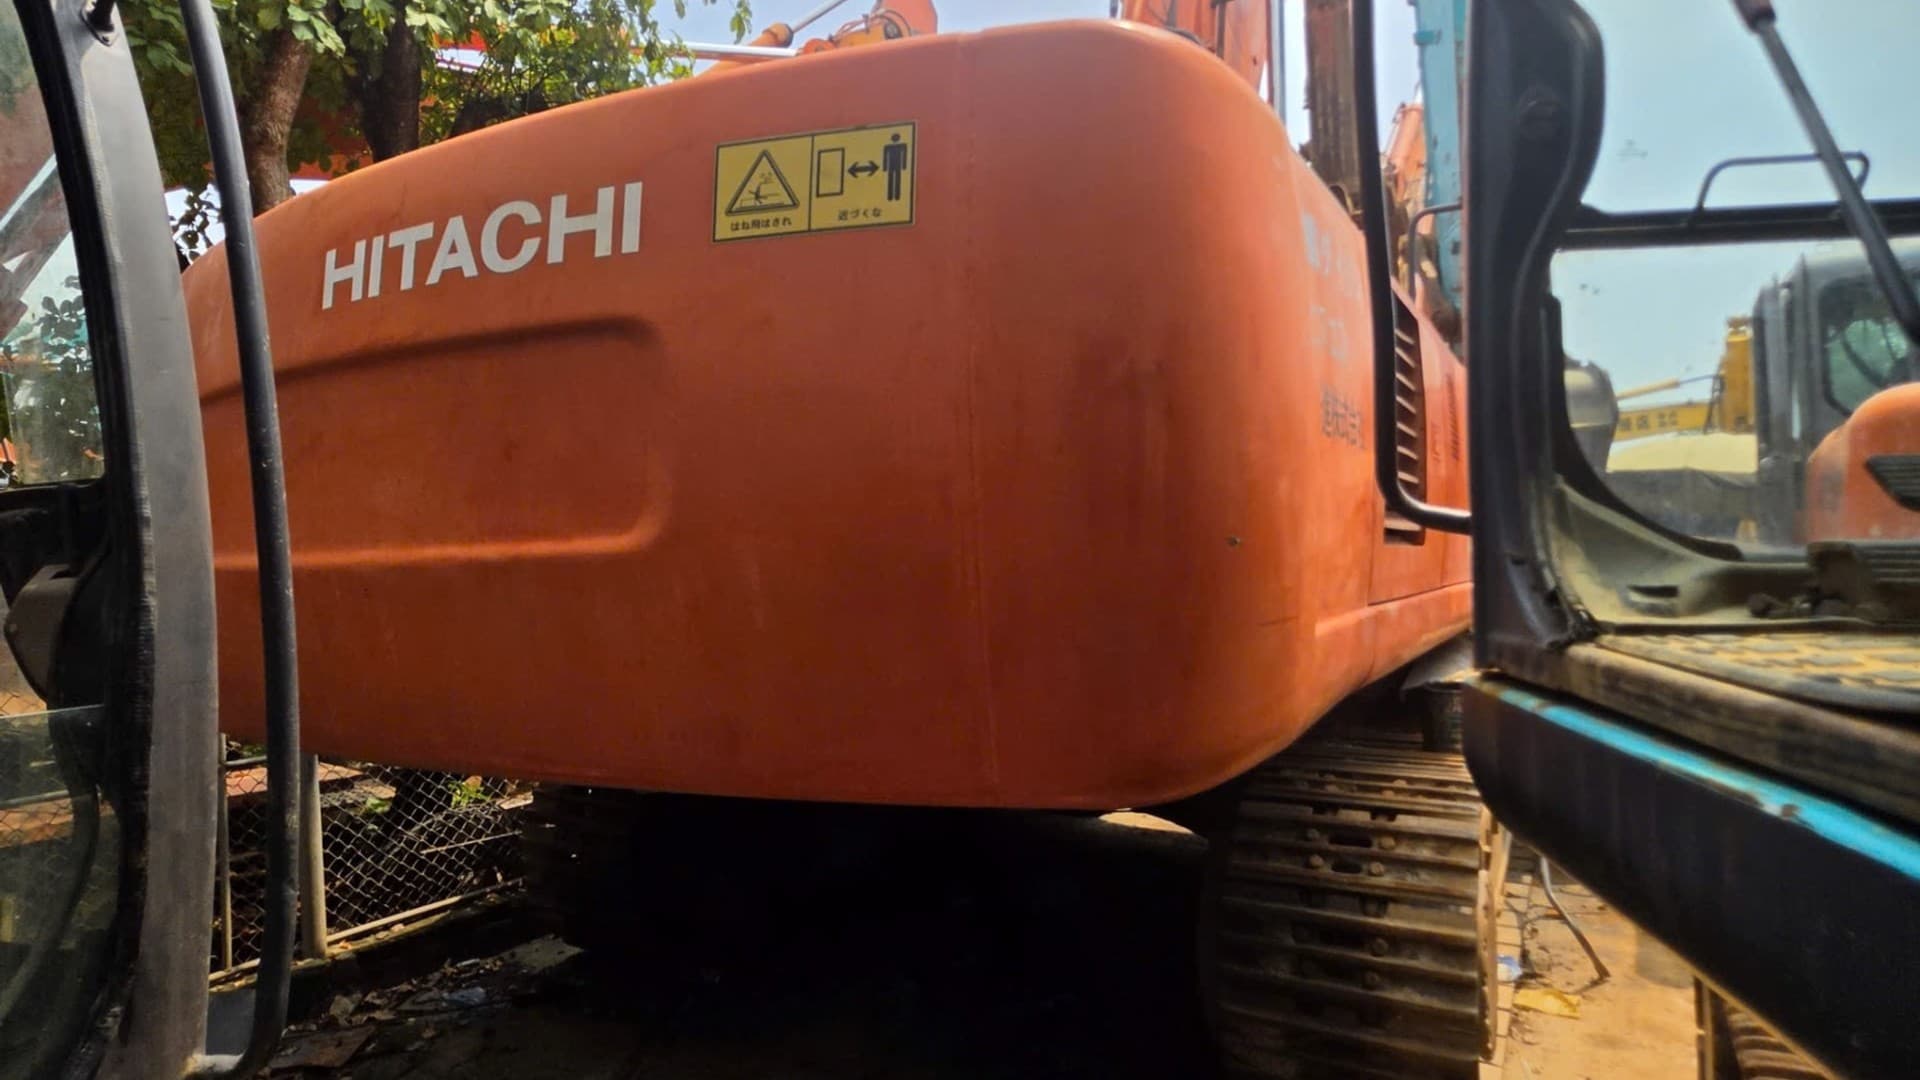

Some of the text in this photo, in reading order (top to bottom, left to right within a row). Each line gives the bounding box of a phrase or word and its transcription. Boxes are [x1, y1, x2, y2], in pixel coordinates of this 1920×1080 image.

[321, 181, 643, 310] HITACHI
[837, 208, 882, 221] 近づくな
